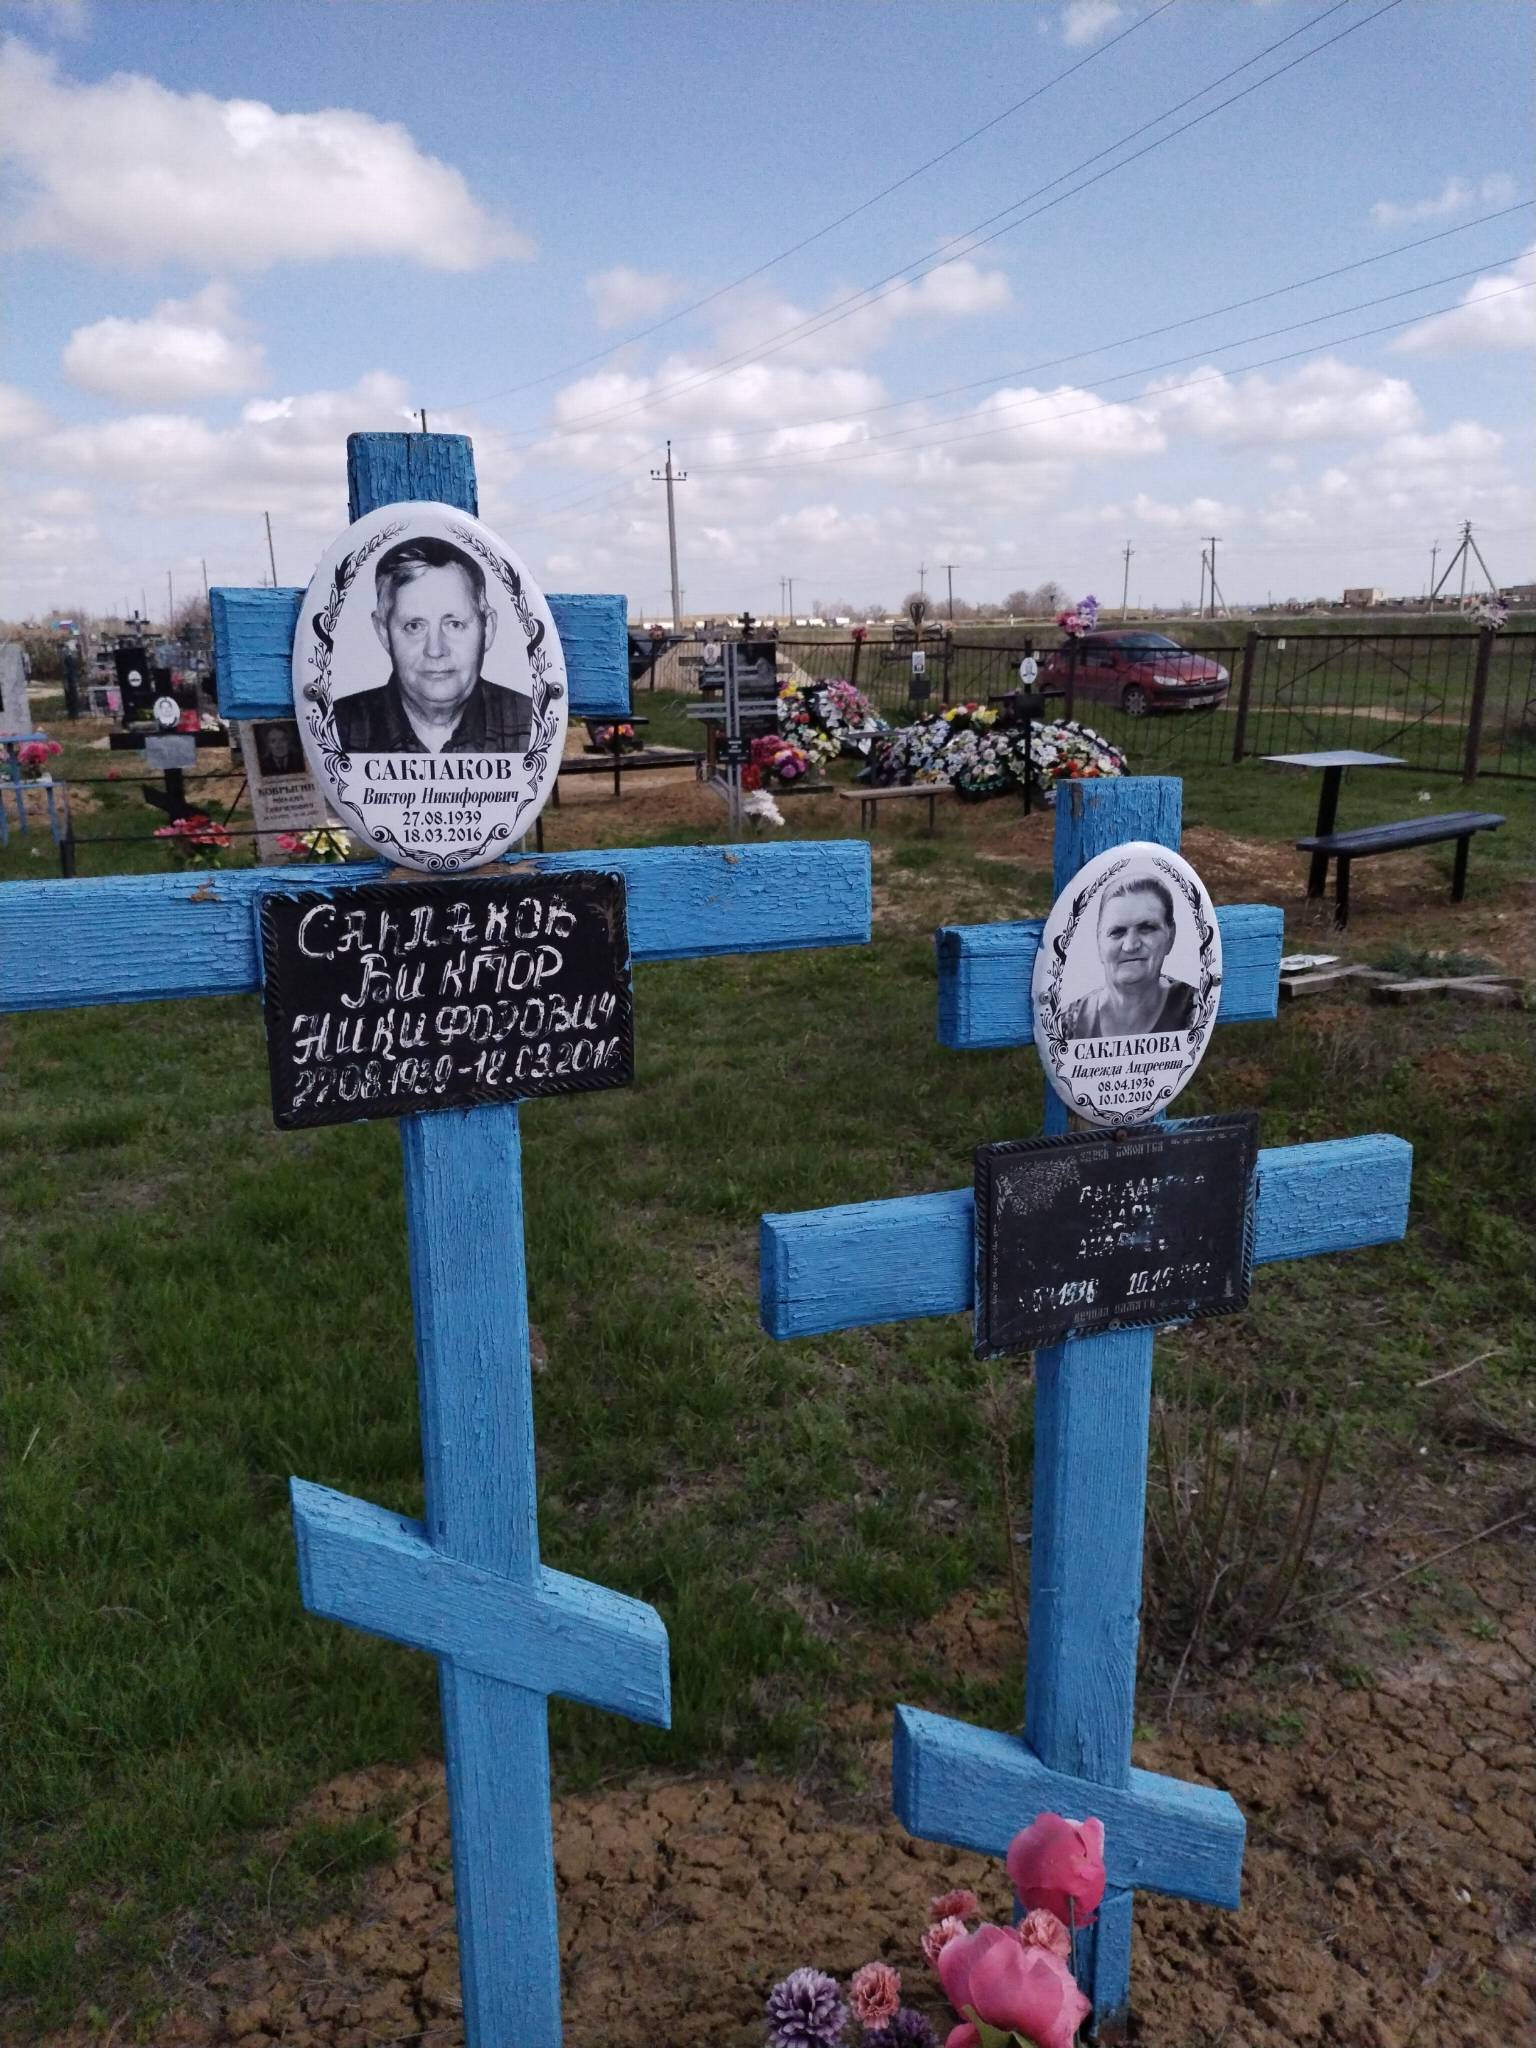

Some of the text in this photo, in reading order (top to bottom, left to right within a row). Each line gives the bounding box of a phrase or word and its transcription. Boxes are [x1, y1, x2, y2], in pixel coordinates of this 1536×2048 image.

[364, 758, 512, 782] САКЛАКОВ
[363, 788, 519, 808] Виктор Никифорович
[402, 810, 482, 826] 27.08.1939
[403, 828, 482, 843] 18.03.2016
[1074, 1035, 1181, 1060] САКЛАКОВА
[1071, 1058, 1183, 1079] Надежда Андреевна
[1098, 1076, 1155, 1093] 08.04.1936
[1099, 1090, 1153, 1106] 10.10.2010
